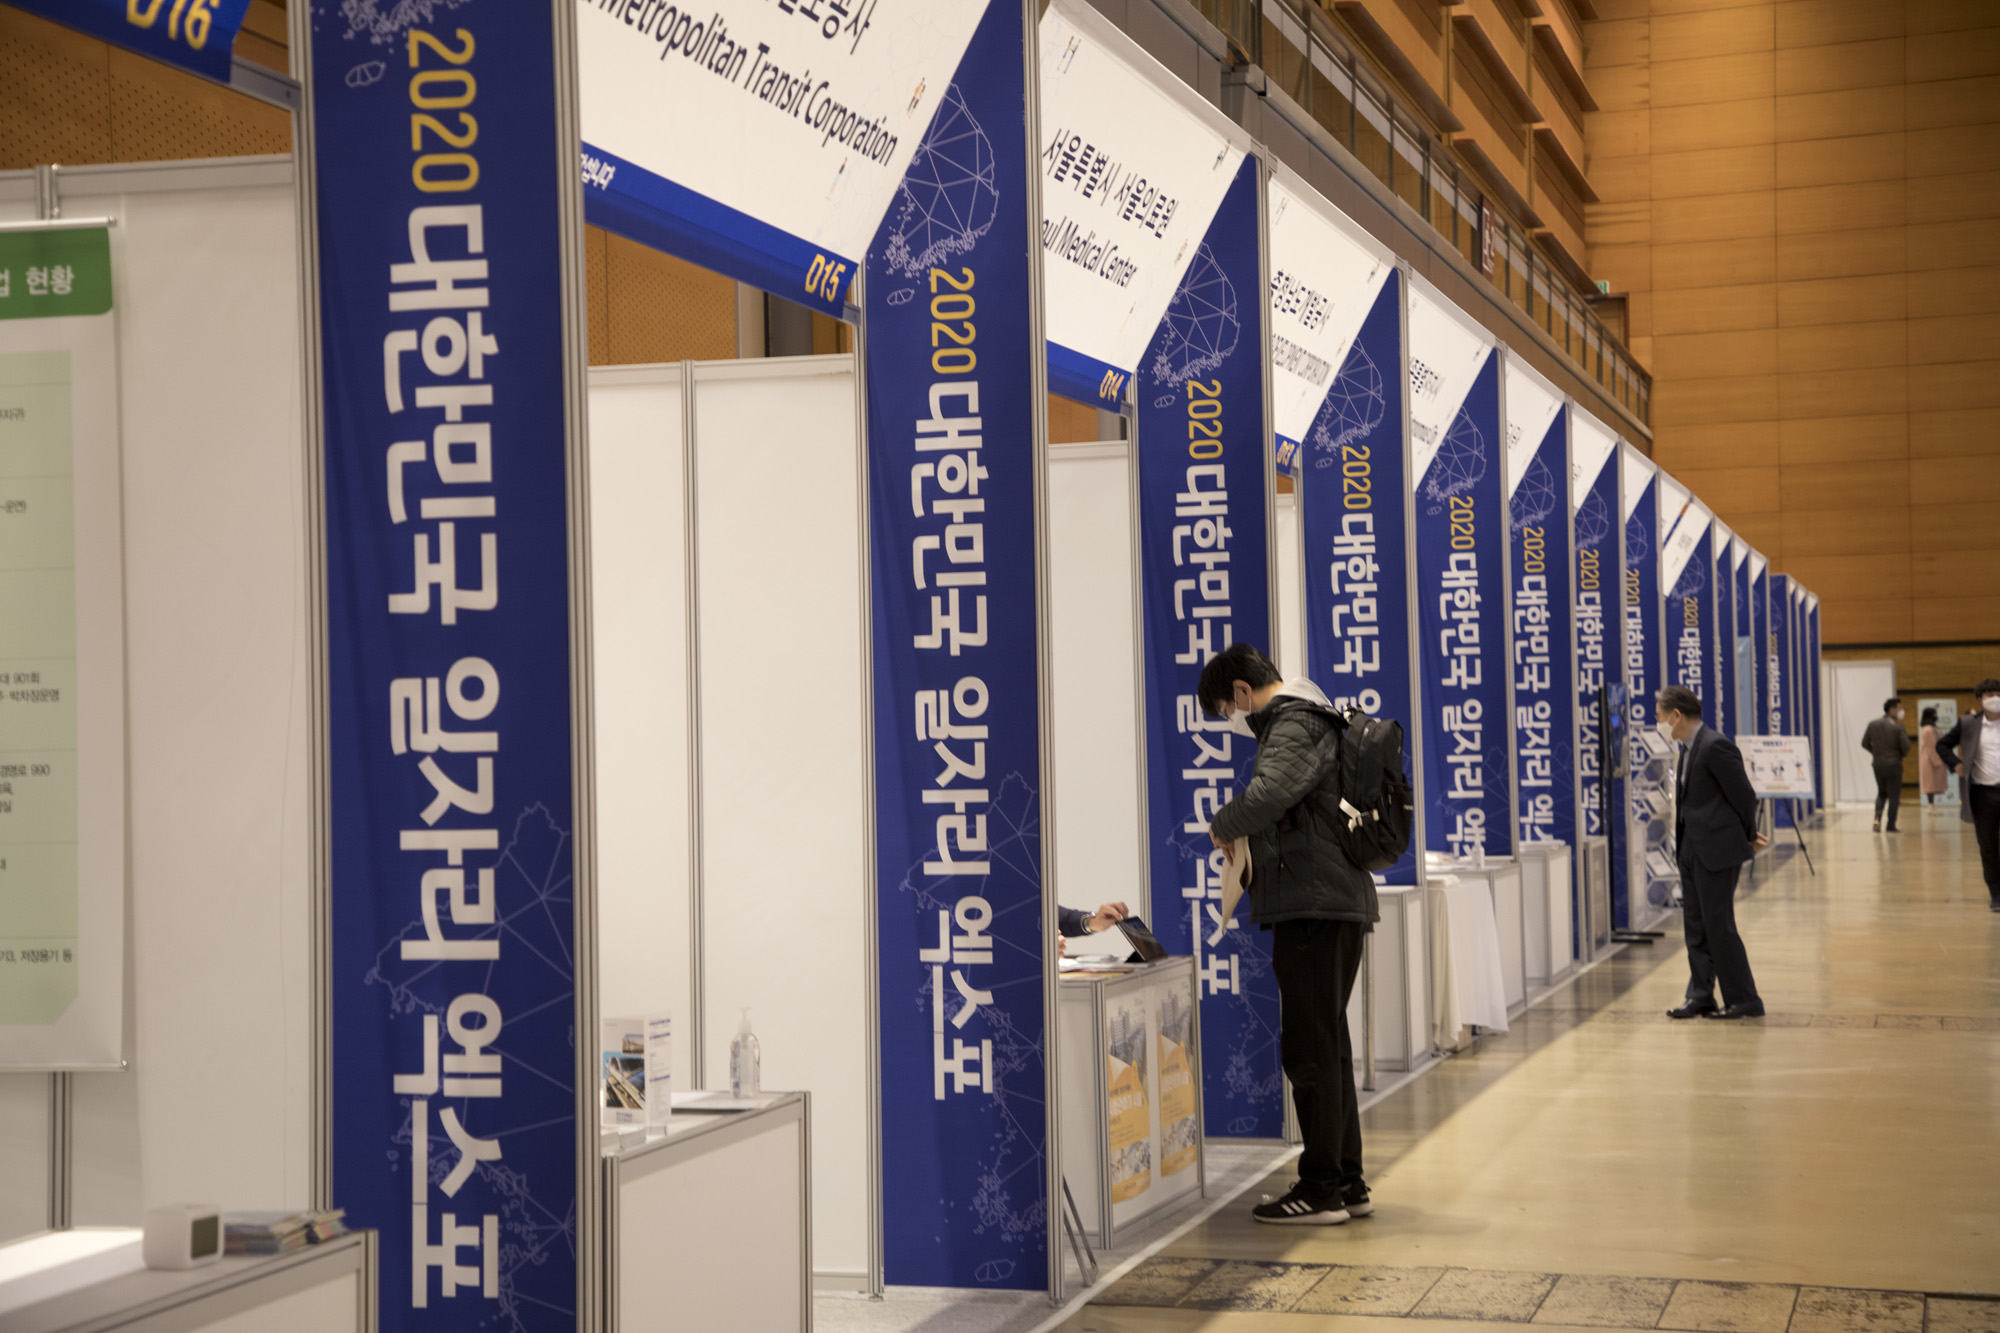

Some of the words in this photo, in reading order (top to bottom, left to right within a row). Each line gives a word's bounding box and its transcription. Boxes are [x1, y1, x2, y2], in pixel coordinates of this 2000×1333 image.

[408, 28, 480, 193] 2020
[743, 42, 812, 118] Transit
[803, 80, 898, 167] Corporation
[1043, 128, 1122, 207] 서울특별시
[1114, 172, 1180, 240] 서울의료원
[26, 265, 76, 296] 현황
[1056, 220, 1110, 273] Medical
[1099, 239, 1138, 288] Center
[930, 266, 977, 375] 2020
[384, 204, 500, 625] 대한민국
[1187, 379, 1223, 460] 2020
[911, 381, 990, 657] 대한민국
[1342, 445, 1372, 509] 2020
[1449, 496, 1475, 550] 2020
[1172, 464, 1234, 668] 대한민국
[1330, 512, 1380, 678] 대한민국
[1523, 526, 1546, 573] 2020
[1580, 548, 1600, 591] 2020
[1626, 568, 1641, 606] 2020
[1440, 552, 1482, 690] 대한민국
[1514, 574, 1551, 694] 대한민국
[1575, 591, 1605, 695] 대한민국
[1683, 596, 1699, 627] 2020
[915, 675, 990, 876] 일자리
[1442, 698, 1484, 799] 일자리
[1516, 700, 1552, 787] 일자리
[390, 656, 500, 961] 일자리
[919, 895, 995, 1101] 엑스포
[393, 993, 503, 1309] 엑스포
